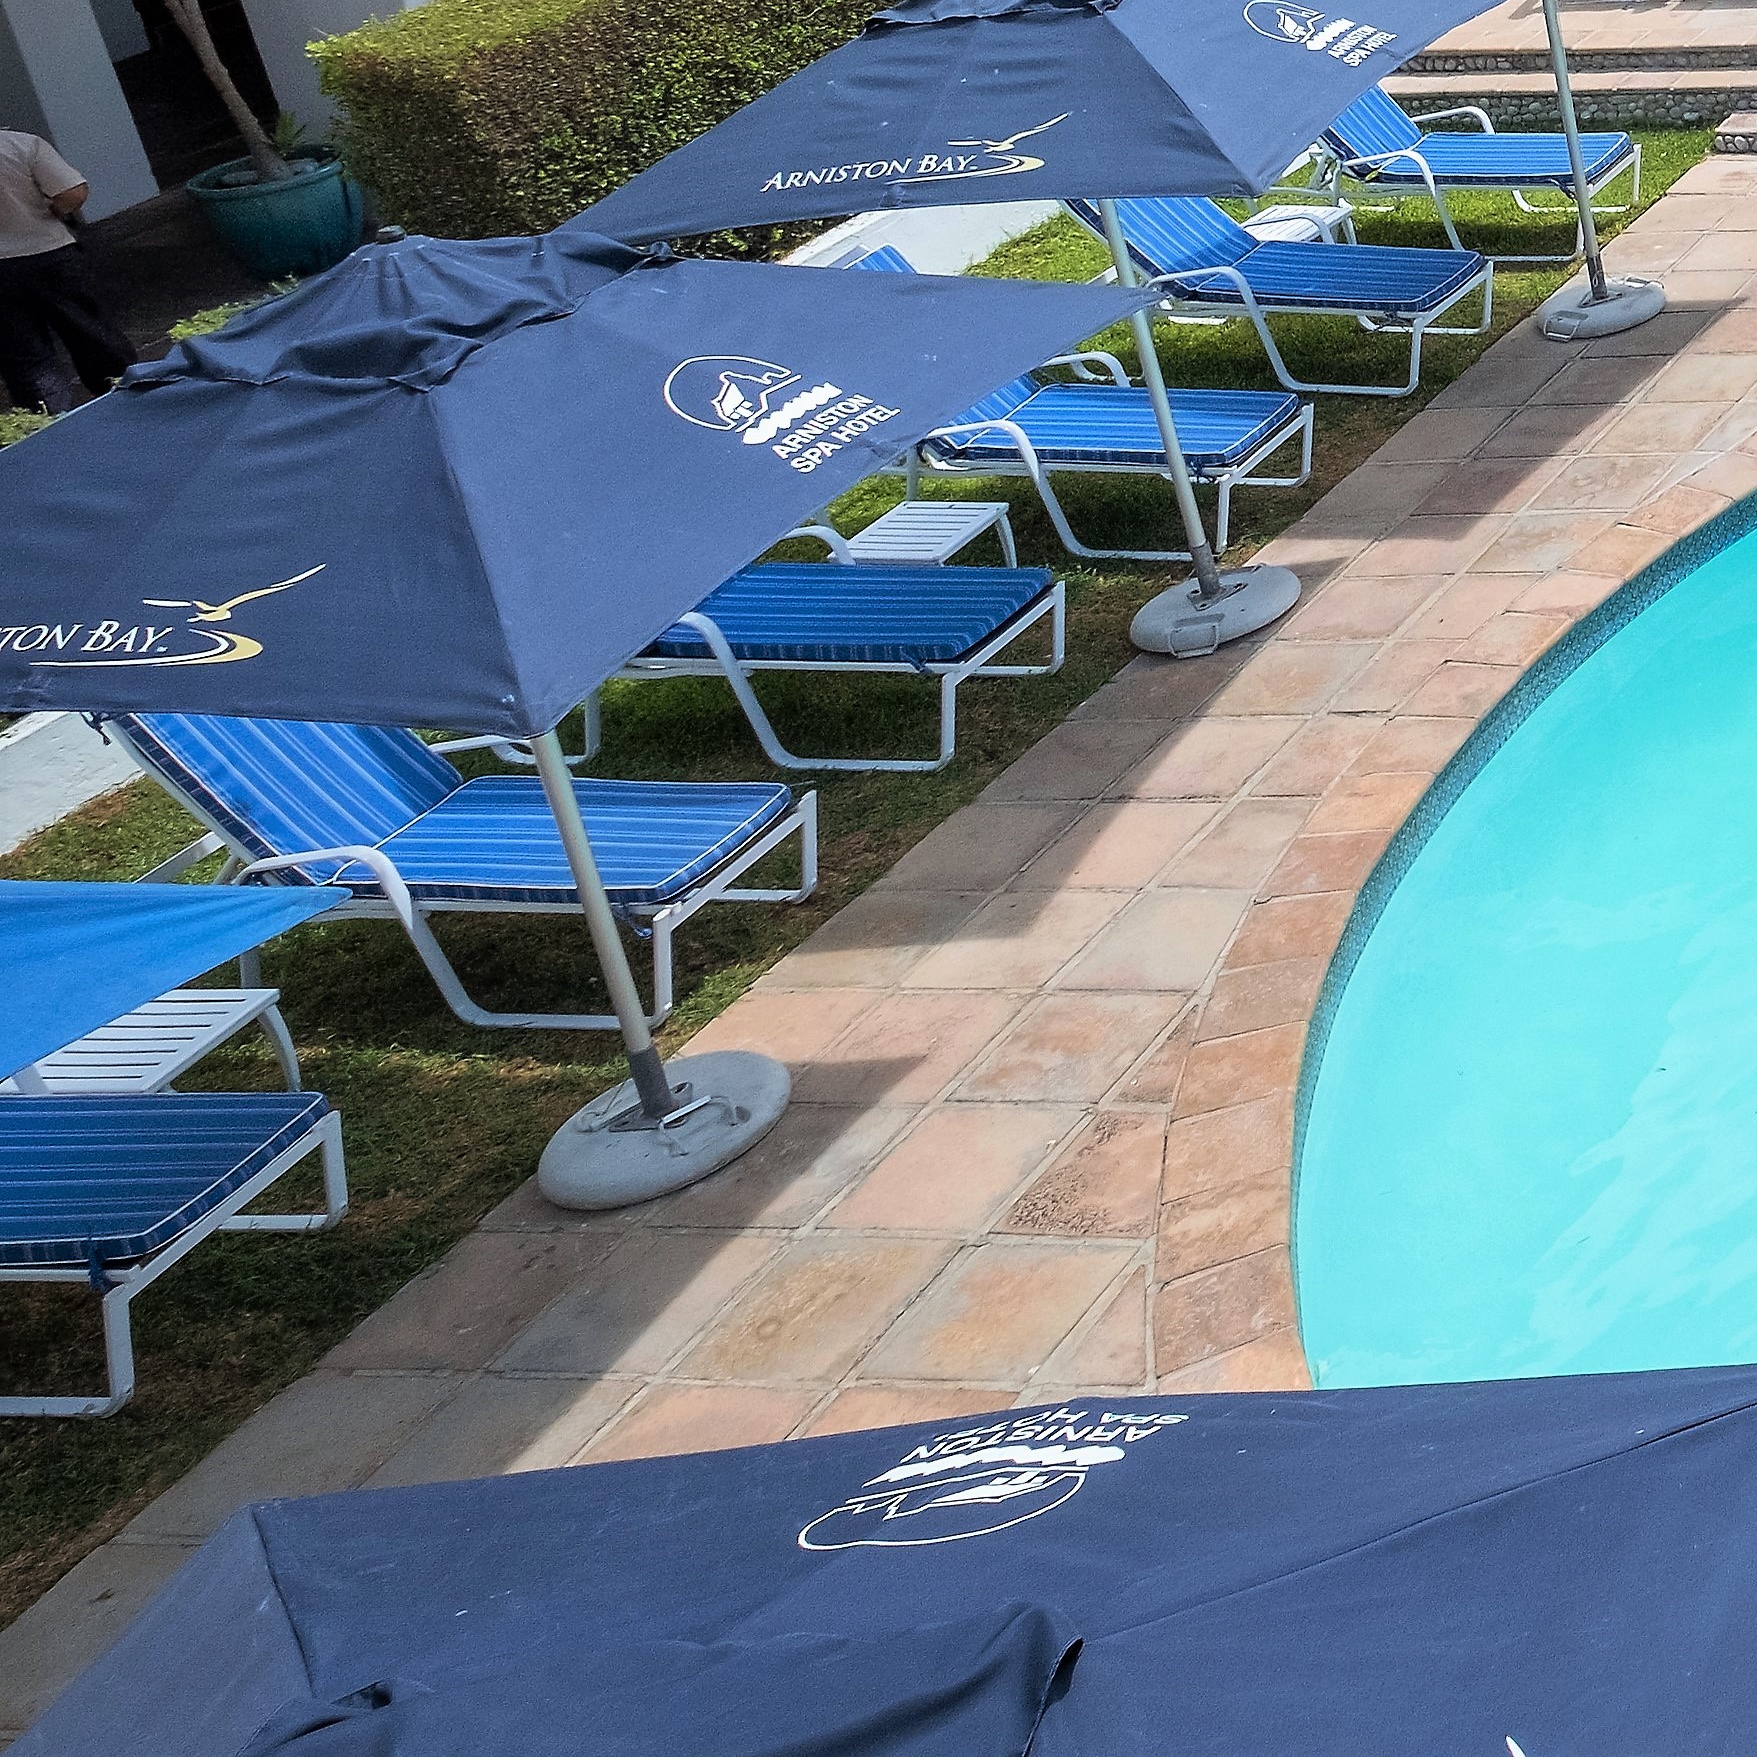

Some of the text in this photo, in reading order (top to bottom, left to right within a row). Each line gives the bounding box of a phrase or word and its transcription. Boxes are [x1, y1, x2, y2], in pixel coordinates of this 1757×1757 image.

[760, 153, 977, 193] ARNISTON BAY
[771, 393, 875, 460] ARNISTON
[790, 403, 902, 474] SPA HOTEL
[80, 619, 174, 653] BAY
[1099, 1411, 1190, 1426] SPA
[899, 1424, 1163, 1464] ARNISTON
